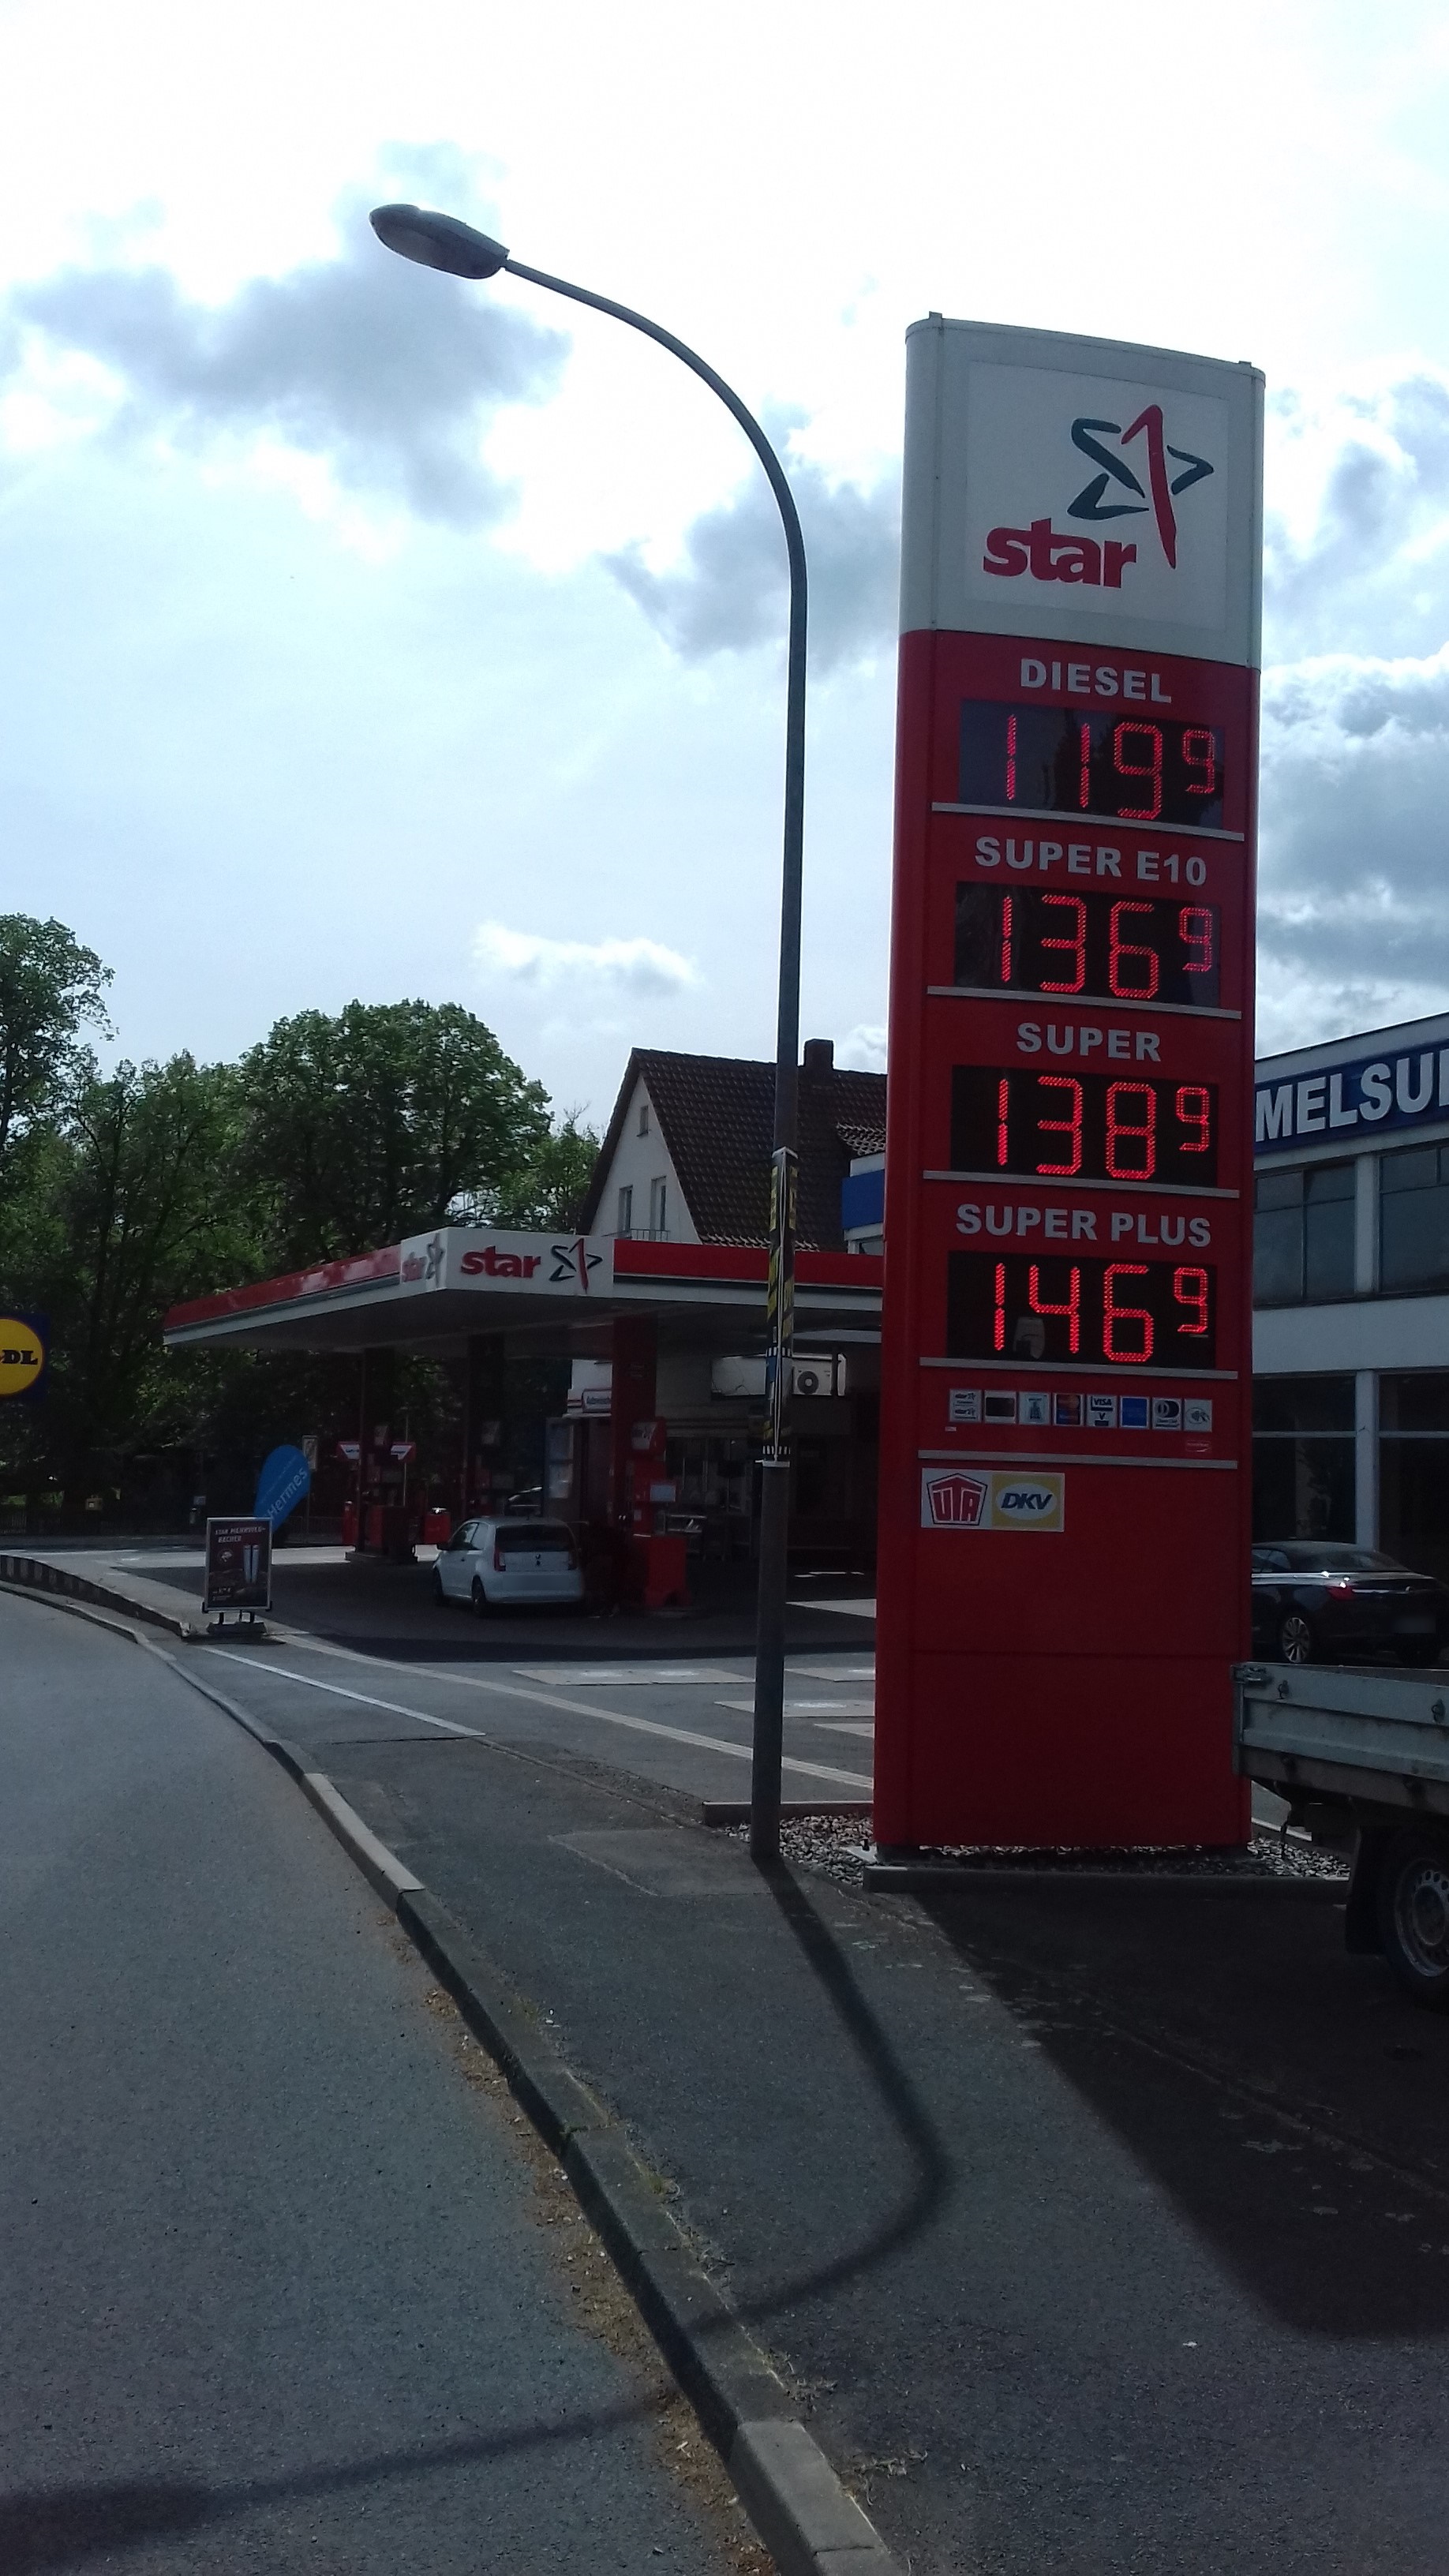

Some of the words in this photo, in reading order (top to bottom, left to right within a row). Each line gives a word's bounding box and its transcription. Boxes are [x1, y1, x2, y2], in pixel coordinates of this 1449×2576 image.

[982, 517, 1137, 589] star
[1020, 658, 1172, 704] DIESEL
[975, 837, 1122, 878] SUPER
[1136, 851, 1208, 887] E10
[1016, 1022, 1162, 1062] SUPER
[956, 1204, 1098, 1241] SUPER
[1110, 1212, 1211, 1247] PLUS
[460, 1245, 541, 1279] star
[0, 1350, 38, 1365] DL
[1093, 1398, 1112, 1406] VISA
[267, 1466, 308, 1518] Hermes
[930, 1475, 985, 1523] UTA
[1001, 1492, 1054, 1510] DKV
